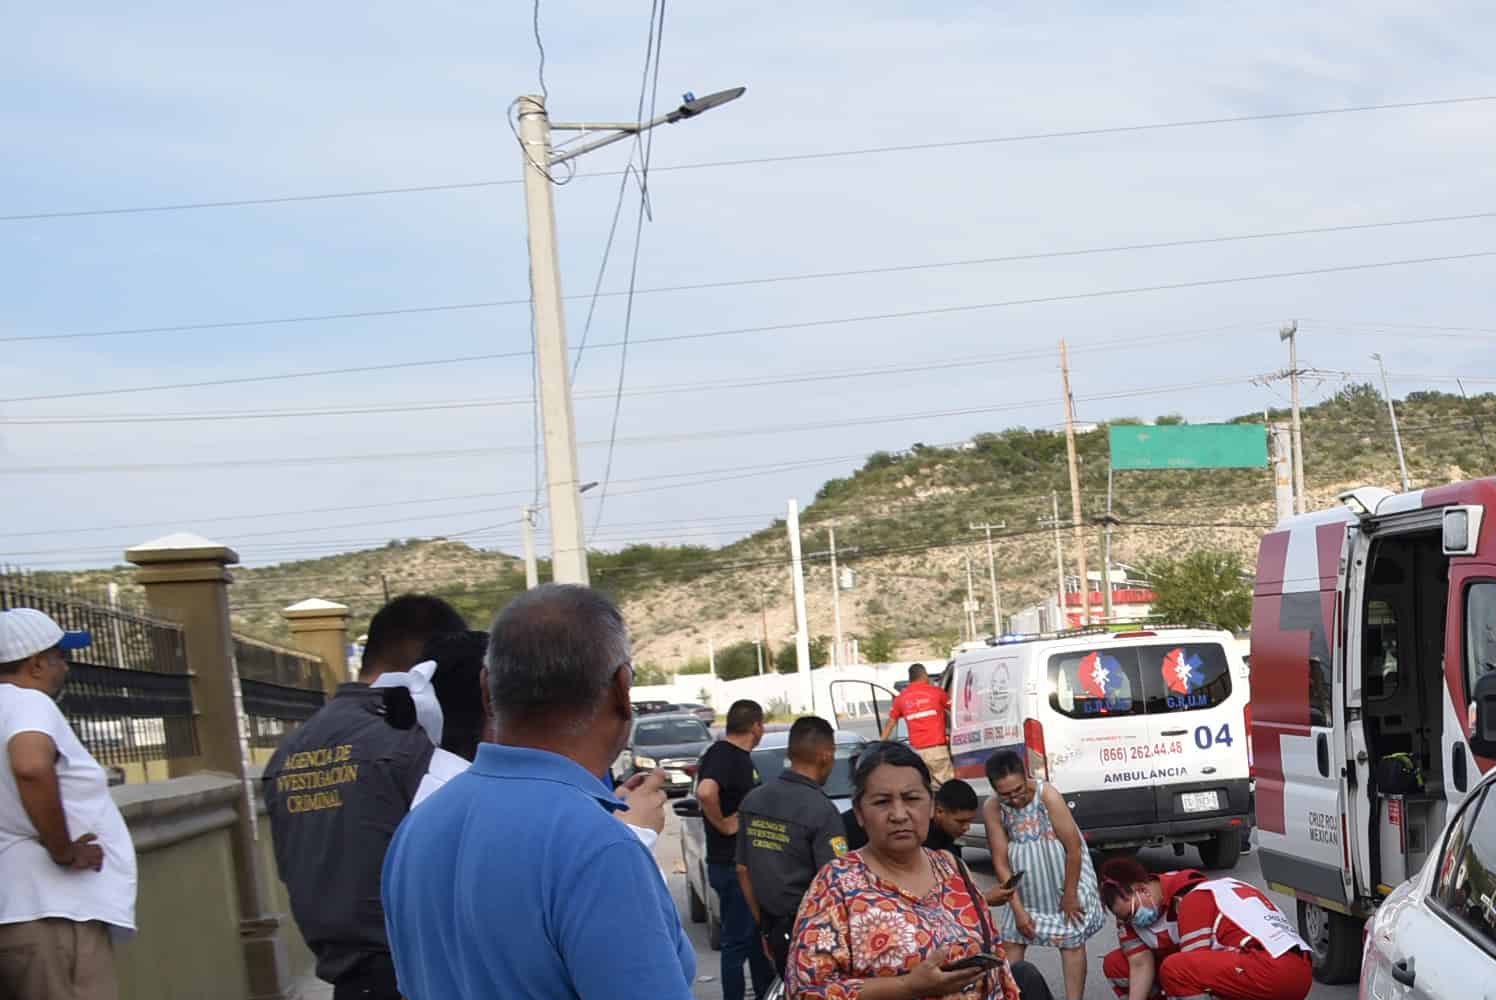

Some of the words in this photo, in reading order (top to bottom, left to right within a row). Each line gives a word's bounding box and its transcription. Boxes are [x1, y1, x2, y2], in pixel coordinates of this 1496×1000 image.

[1194, 723, 1233, 750] 04
[286, 749, 333, 769] AGENCIA
[335, 744, 353, 763] DE
[1099, 746, 1128, 766] (866)
[1103, 766, 1188, 784] AMBULANCIA
[287, 789, 344, 813] CRIMINAL
[1308, 811, 1325, 829] CRUZ
[1326, 815, 1338, 831] ROJ
[1309, 828, 1338, 846] MEXICAN
